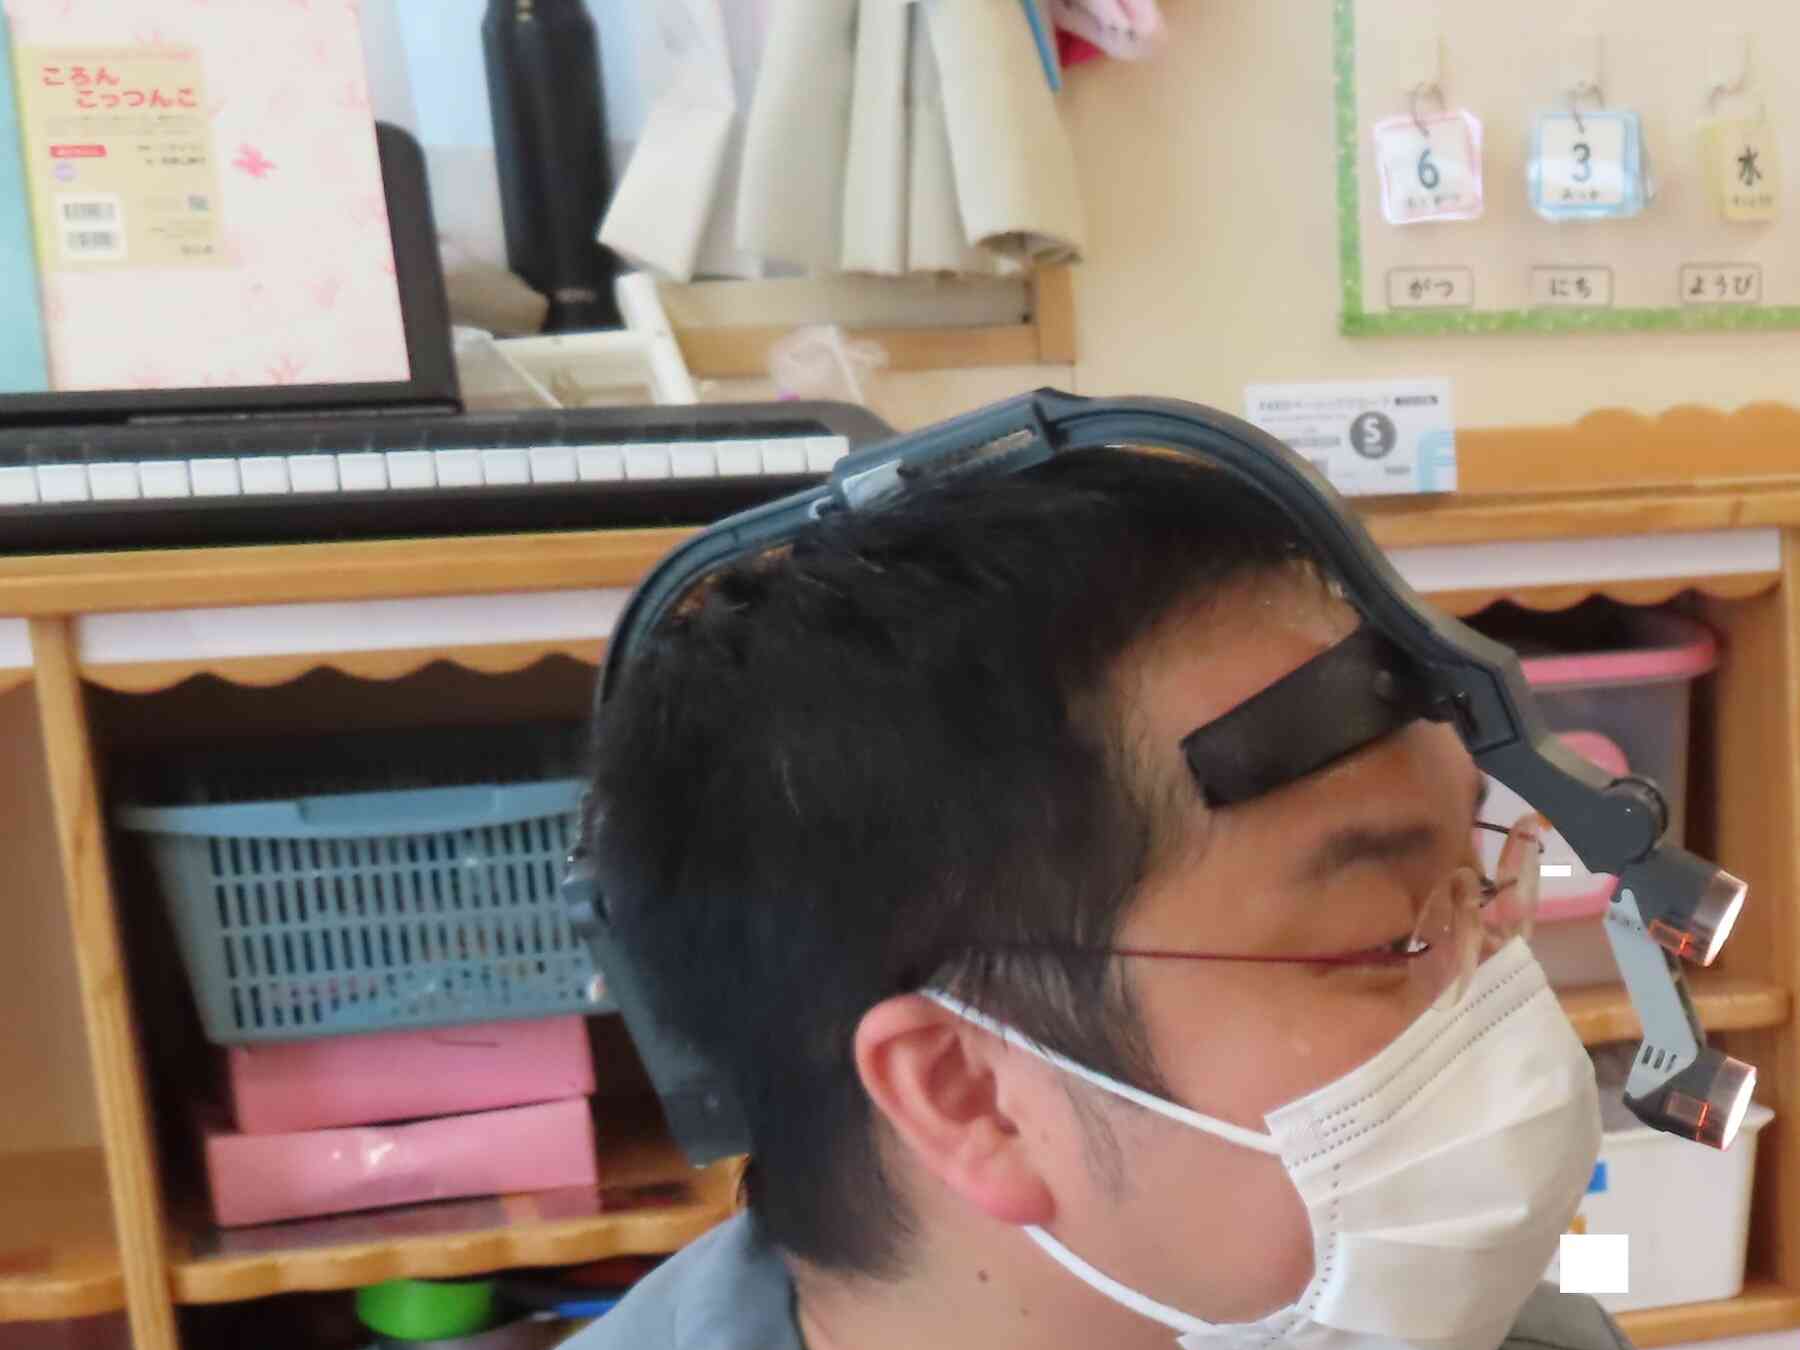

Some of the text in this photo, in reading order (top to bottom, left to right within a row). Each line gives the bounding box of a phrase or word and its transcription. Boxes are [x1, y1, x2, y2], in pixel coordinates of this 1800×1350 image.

[1417, 148, 1440, 190] 6
[1572, 143, 1592, 182] 3
[1737, 146, 1762, 187] 水
[1408, 277, 1454, 299] がつ
[1551, 276, 1592, 298] にち
[1690, 275, 1753, 296] ようび
